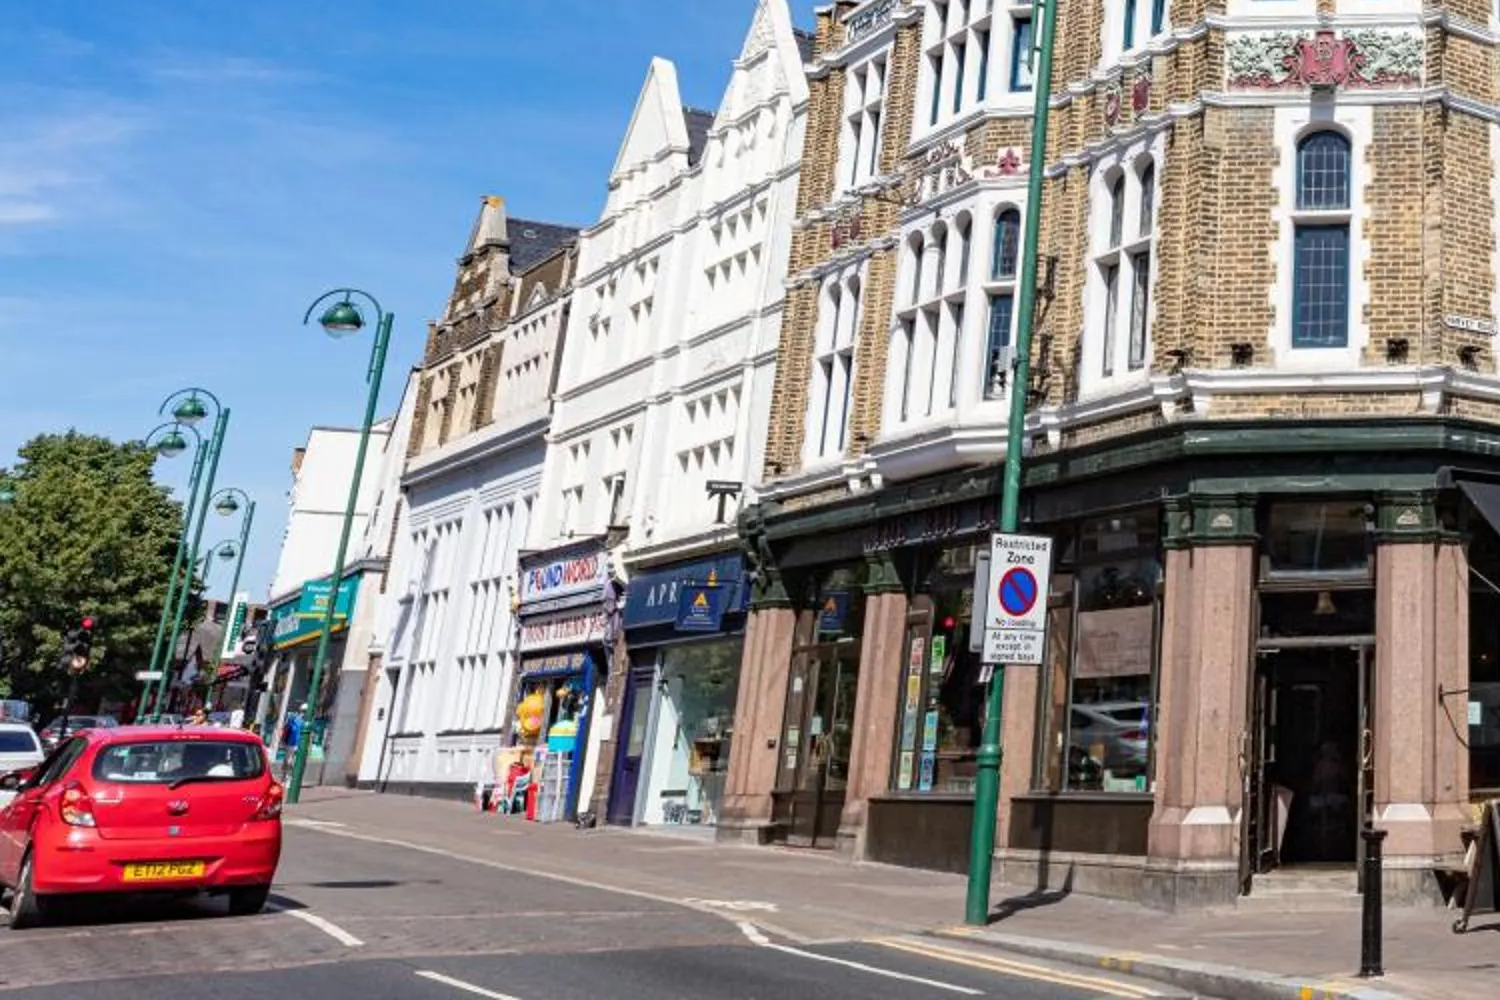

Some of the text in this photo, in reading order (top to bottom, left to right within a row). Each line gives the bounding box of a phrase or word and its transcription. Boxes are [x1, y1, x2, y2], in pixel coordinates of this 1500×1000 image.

[995, 537, 1048, 551] Restricted
[1007, 551, 1035, 564] Zone
[528, 565, 563, 593] POUND
[995, 617, 1005, 627] No
[992, 631, 1036, 641] At any time
[995, 642, 1021, 651] except
[990, 651, 1036, 662] signed bays
